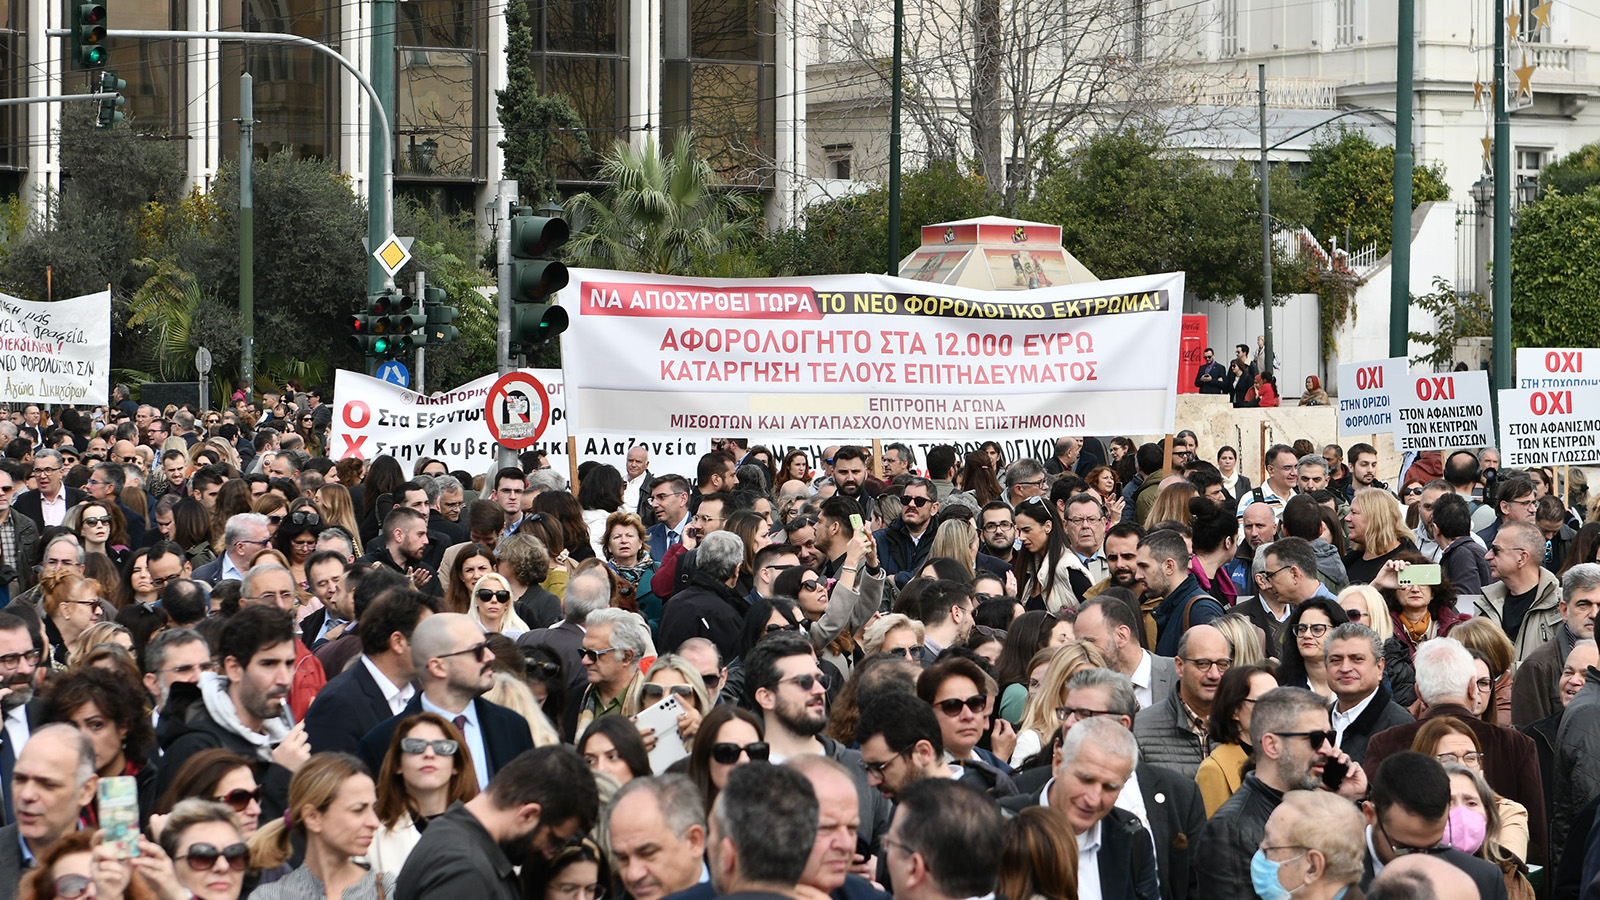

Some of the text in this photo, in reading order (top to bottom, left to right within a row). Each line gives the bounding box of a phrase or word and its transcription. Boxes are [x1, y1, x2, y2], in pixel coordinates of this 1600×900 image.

[590, 289, 1161, 319] ΝΑ ΑΠΟΣΥΡΘΕΙ ΤΩΡΑ ΤΟ ΝΕΟ ΦΟΡΟΛΟΓΙΚΟ ΕΚΤΡΩΜΑ!
[659, 328, 1094, 357] ΑΦΟΡΟΛΟΓΗΤΟ ΣΤΑ 12.000 ΕΥΡΩ
[1545, 351, 1582, 373] ΟΧΙ
[660, 360, 1098, 385] ΚΑΤΑΡΓΗΣΗ ΤΕΛΟΥΣ ΕΠΙΤΗΔΕΥΜΑΤΟΣ
[1356, 366, 1383, 390] ΟΧΙ
[1416, 376, 1455, 401] ΟΧΙ
[1521, 378, 1600, 389] ΣΤΗ ΣΤΟΧΟΠΟΙΗ
[415, 386, 491, 406] ΔΙΚΗΓΟΡΙΚ
[869, 397, 1006, 413] ΕΠΙΤΡΟΠΗ ΑΓΩΝΑ
[1340, 398, 1360, 412] ΣΤΗΝ
[1530, 391, 1572, 415] ΟΧΙ
[378, 408, 410, 428] Στα
[1399, 404, 1483, 420] ΣΤΟΝ ΑΦΑΝΙΣΜΟ
[670, 413, 1086, 430] ΜΙΣΘΩΤΩΝ ΚΑΙ ΑΥΤΑΠΑΣΧΟΛΟΥΜΕΝΩΝ ΕΠΙΣΤΗΜΟΝΩΝ
[1406, 420, 1478, 435] ΤΩΝ ΚΕΝΤΡΩΝ
[1509, 419, 1600, 435] ΣΤΟΝ ΑΦΑΝΙΣΜΟ
[1402, 433, 1487, 449] ΞΕΝΩΝ ΓΛΩΣΣΩΝ
[1517, 434, 1595, 450] ΤΩΝ ΚΕΝΤΡΩΝ
[375, 441, 426, 461] Στην
[1511, 451, 1548, 465] ΞΕΝΩΝ
